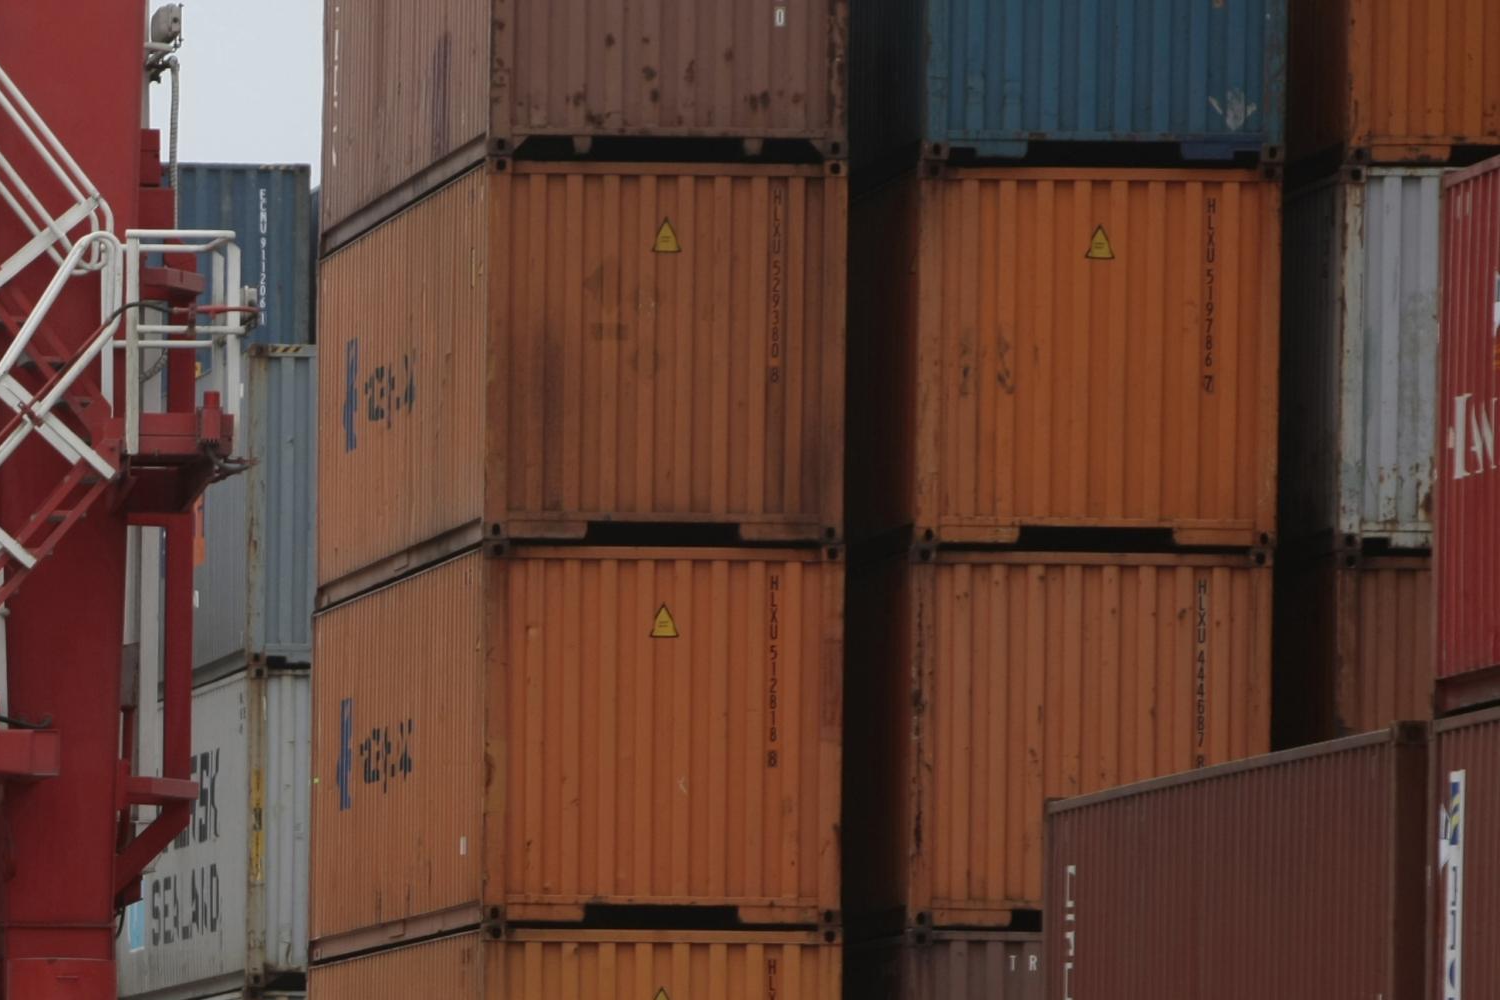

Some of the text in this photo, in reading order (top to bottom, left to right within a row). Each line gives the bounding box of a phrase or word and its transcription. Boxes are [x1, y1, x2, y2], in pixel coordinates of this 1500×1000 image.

[772, 188, 783, 255] HLXU
[1205, 197, 1217, 264] HLXU
[1204, 268, 1215, 368] 519786
[769, 575, 780, 640] HLXU
[1196, 579, 1208, 644] HLXU
[768, 645, 779, 742] 512818
[151, 864, 220, 946] SEALAND
